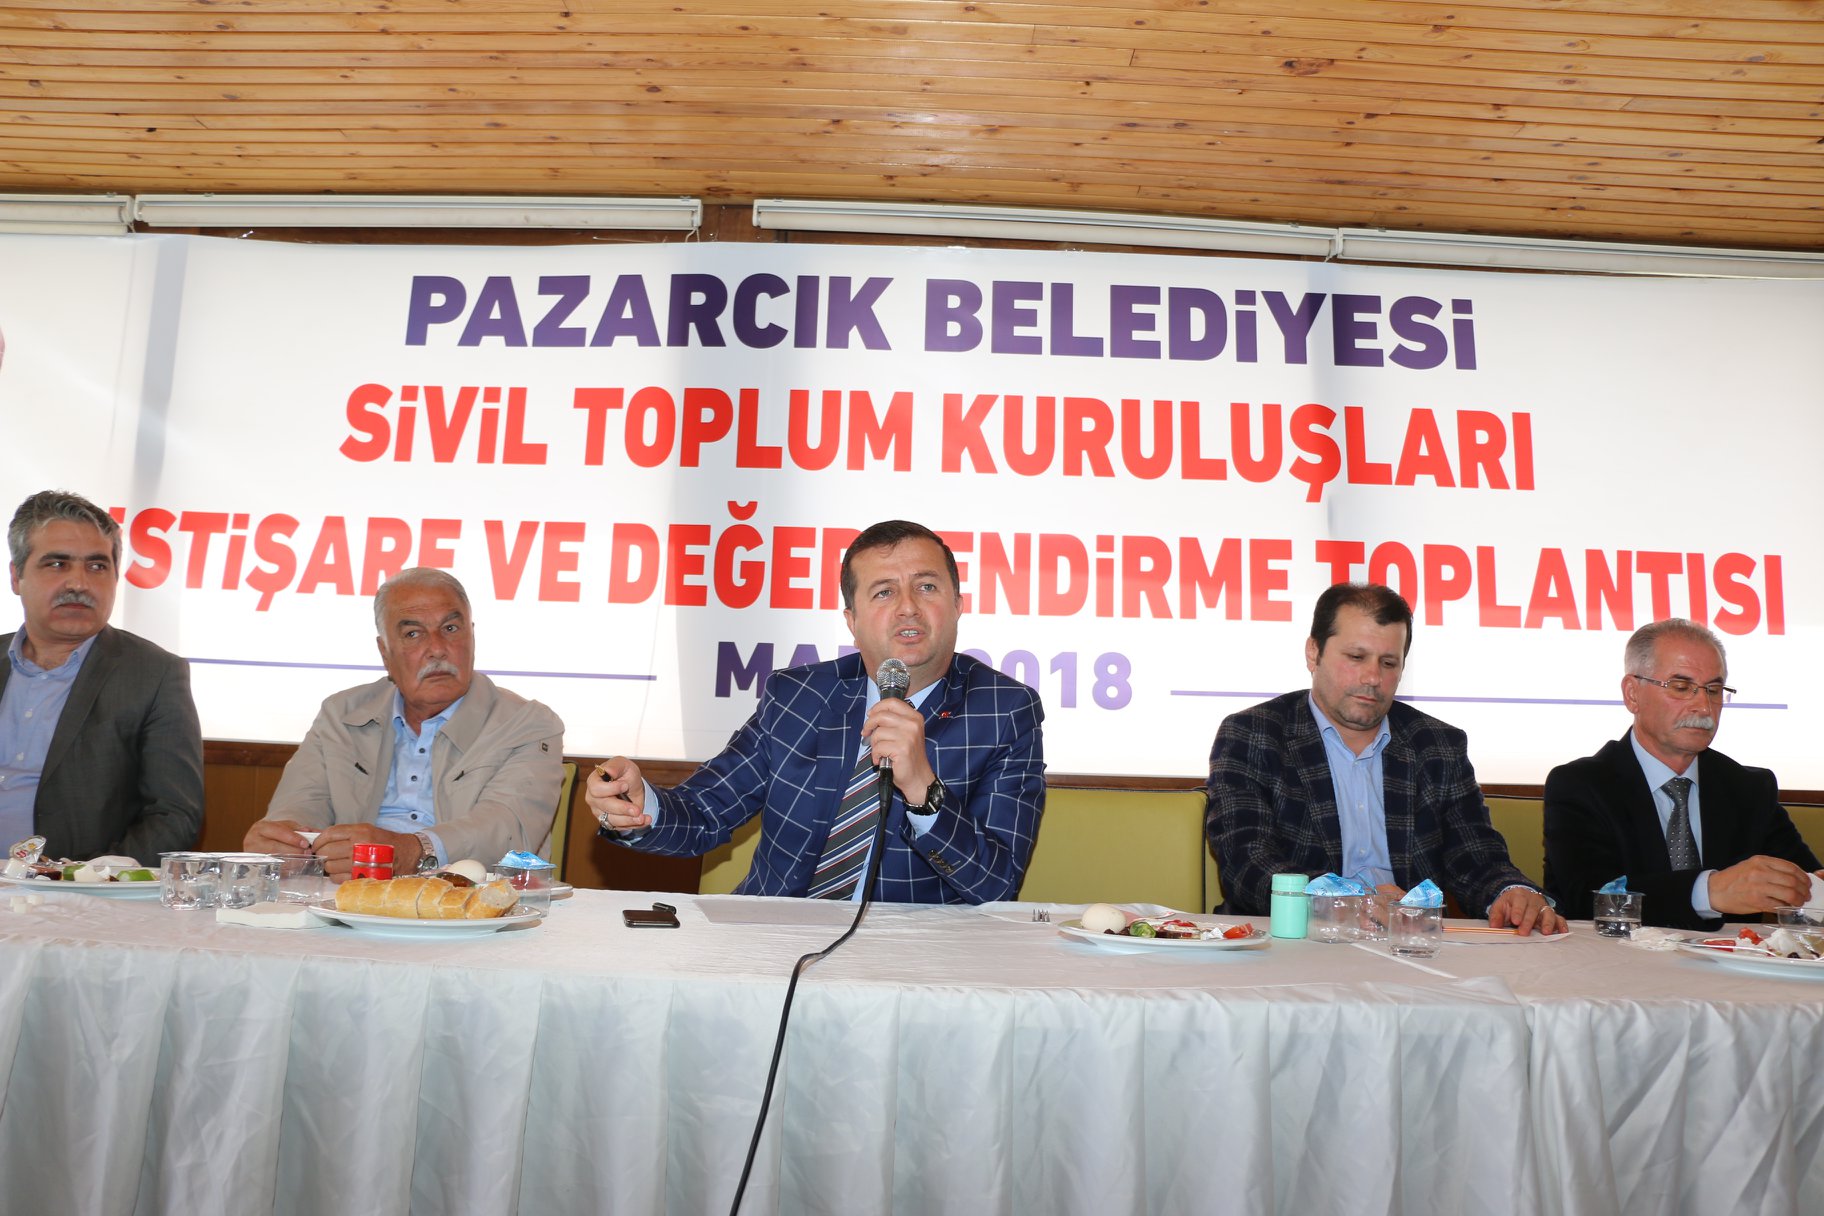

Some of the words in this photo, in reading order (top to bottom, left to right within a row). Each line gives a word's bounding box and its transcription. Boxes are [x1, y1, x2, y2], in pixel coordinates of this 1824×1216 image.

[405, 274, 892, 351] PAZARCIK
[924, 279, 1478, 370] BELEDİYESİ
[339, 382, 549, 466] SİVİL
[572, 385, 915, 473] TOPLUM
[941, 392, 1536, 504] KURULUŞLARI
[109, 506, 463, 612] STİŞARE
[483, 519, 587, 603] VE
[1314, 539, 1786, 636] TOPLANTISI
[961, 648, 1133, 711] 018
